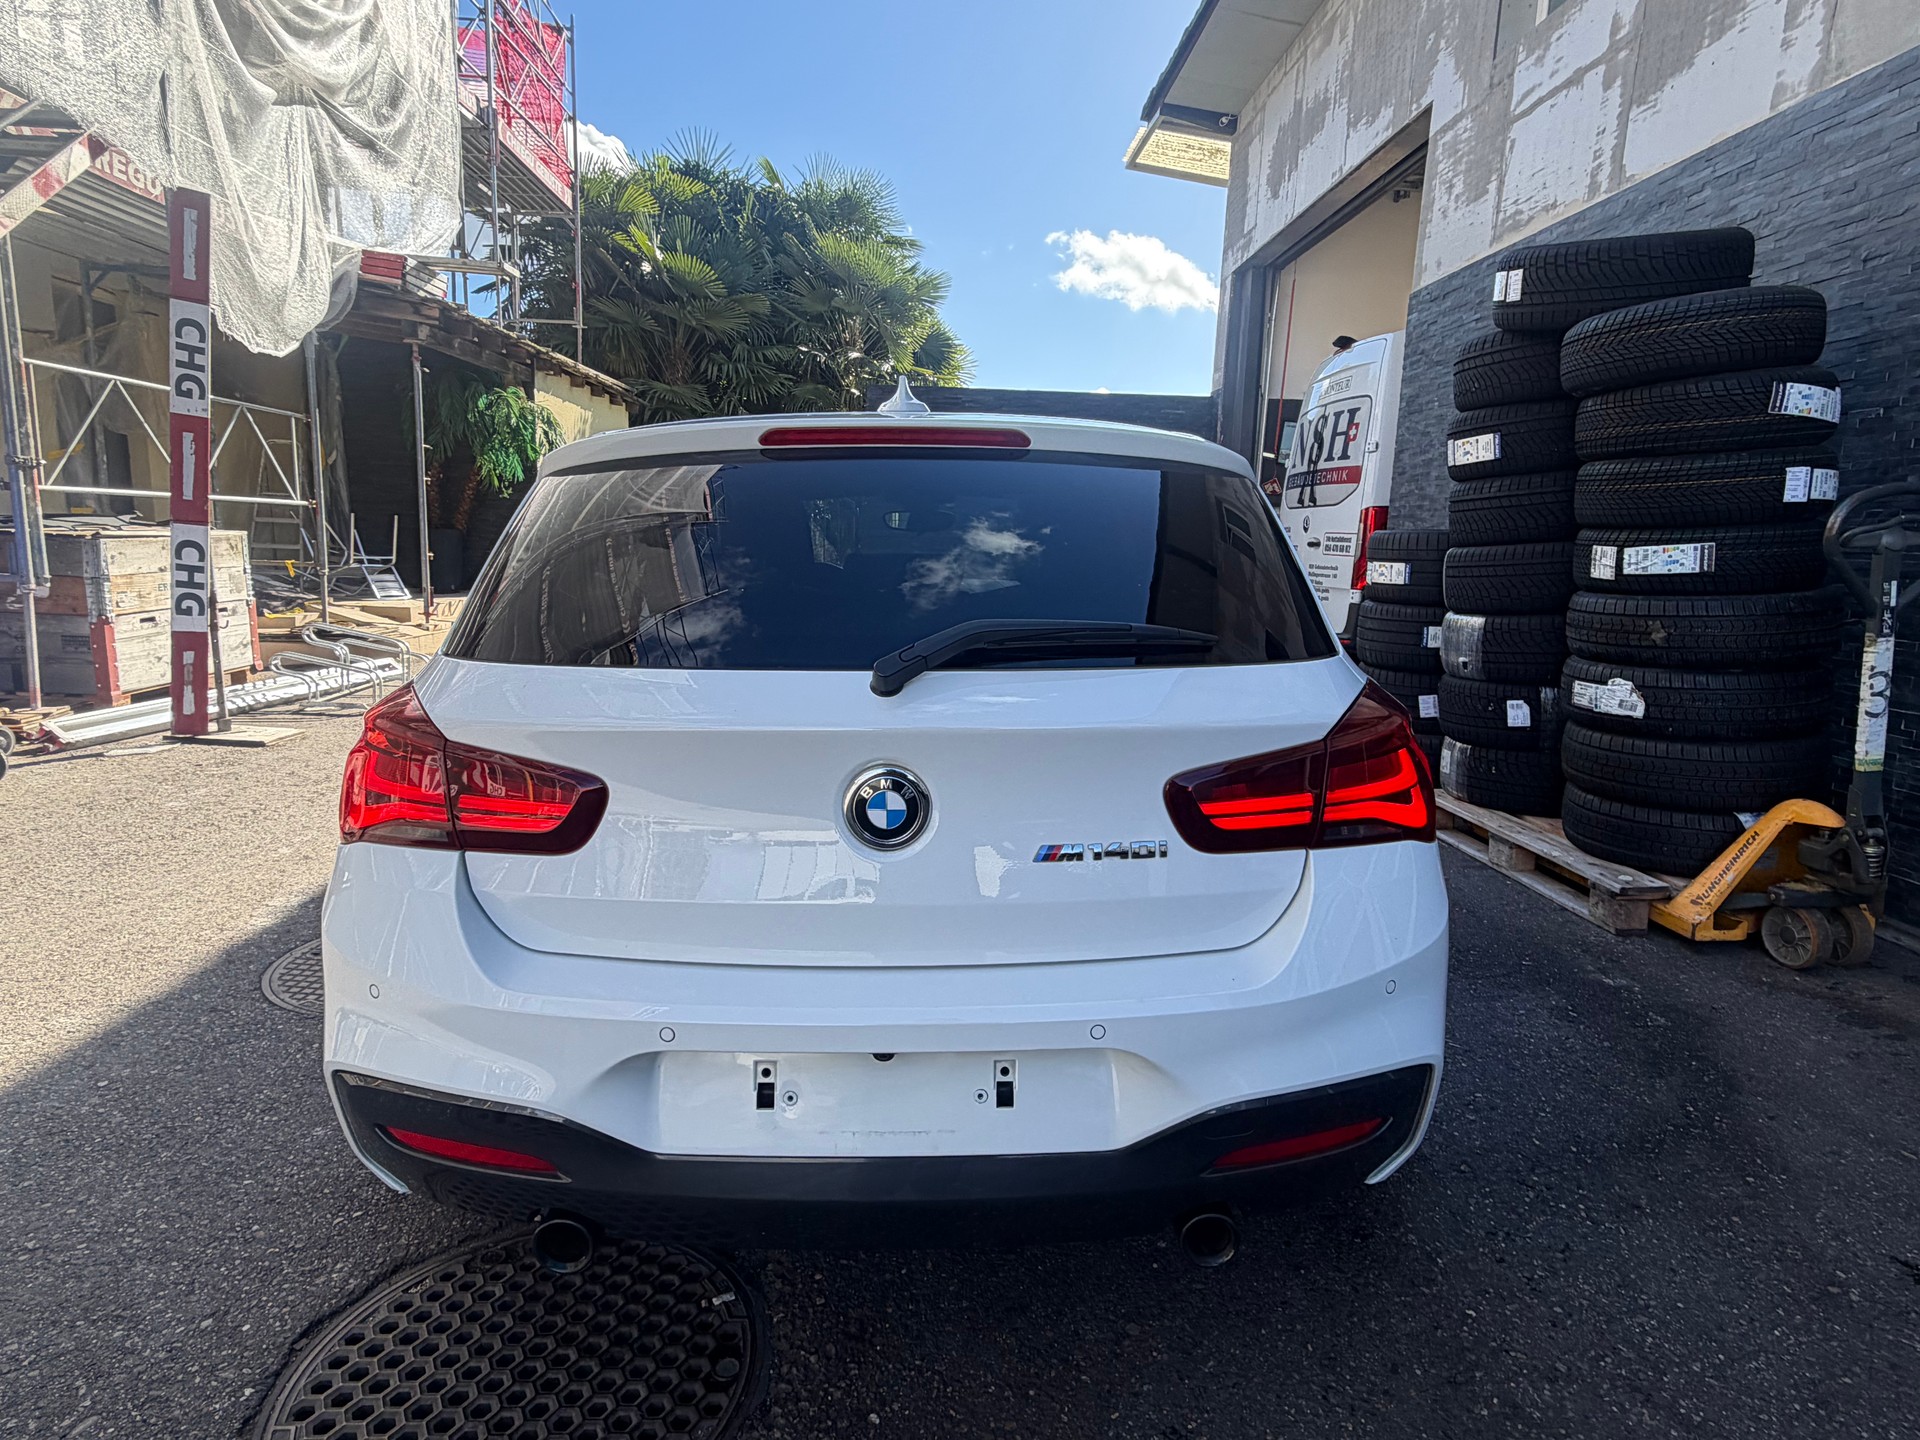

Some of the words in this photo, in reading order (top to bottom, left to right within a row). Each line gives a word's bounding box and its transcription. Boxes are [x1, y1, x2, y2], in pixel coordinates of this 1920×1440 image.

[175, 317, 206, 401] CHG
[1291, 406, 1361, 469] NSH
[174, 539, 206, 617] CHG
[859, 778, 915, 800] BMW
[1058, 840, 1168, 862] M140i
